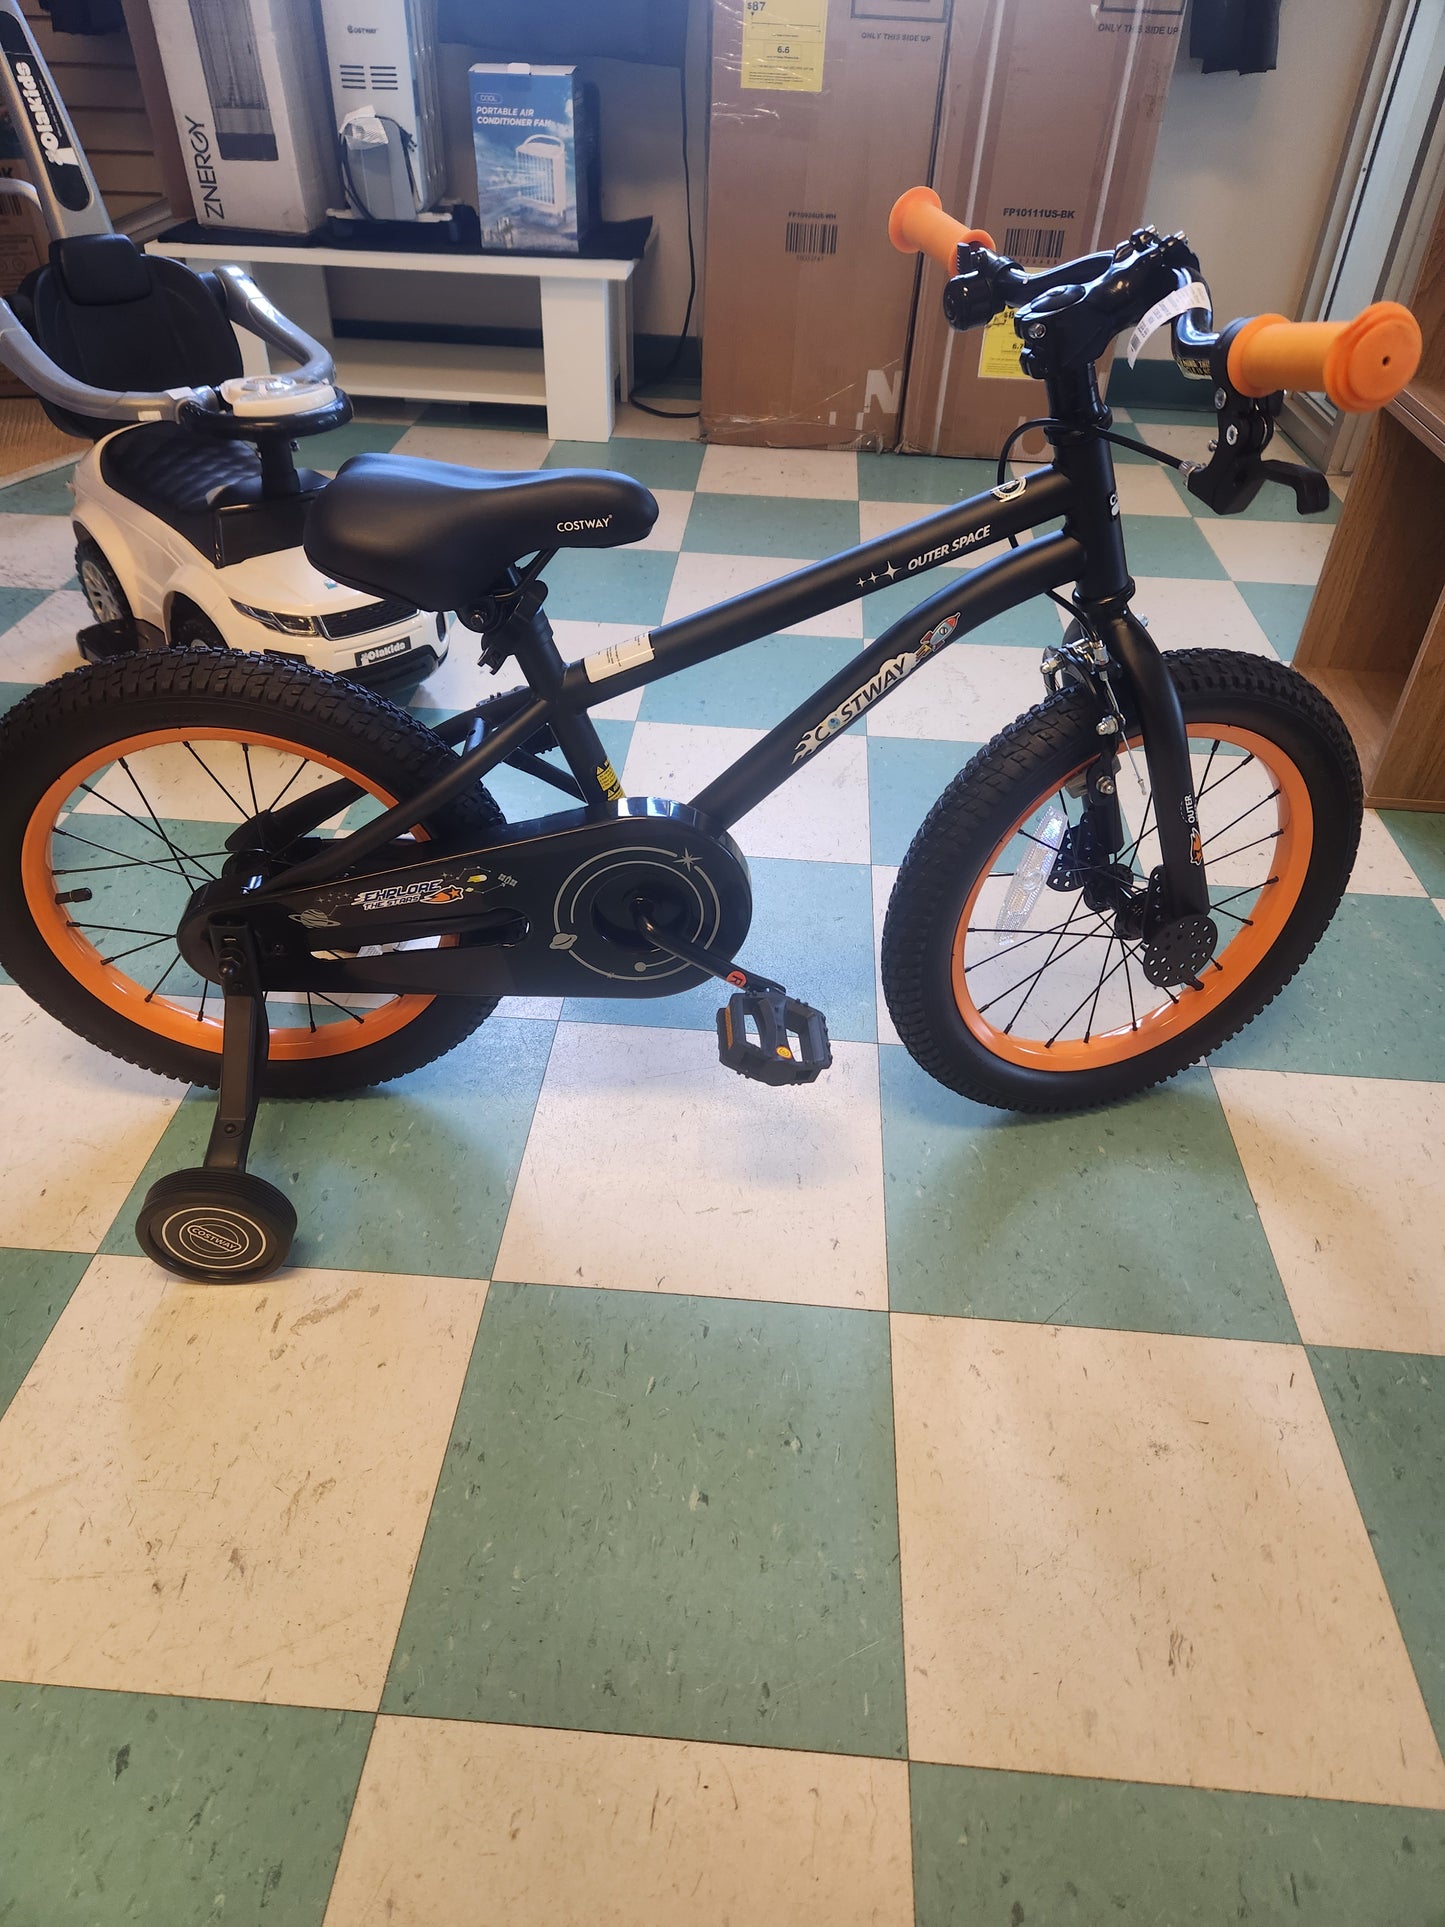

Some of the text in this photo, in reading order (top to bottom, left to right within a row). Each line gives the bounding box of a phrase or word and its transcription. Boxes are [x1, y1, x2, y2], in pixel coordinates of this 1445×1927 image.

[747, 1, 766, 11] $87
[1097, 23, 1179, 35] ONLY THS SIDE UP
[860, 32, 881, 40] ONLY
[901, 34, 920, 42] SIDE
[777, 45, 790, 54] 6.6
[476, 106, 535, 117] PORTABLE AIR
[476, 116, 553, 128] CONDITIONER FAN
[184, 114, 225, 220] ZNERGY
[1002, 207, 1076, 219] FP10111US-BK
[556, 518, 610, 532] COSTWAY
[907, 524, 991, 571] OUTER SPACE
[1184, 794, 1196, 824] OUTER
[191, 1227, 237, 1250] COSTWAY
